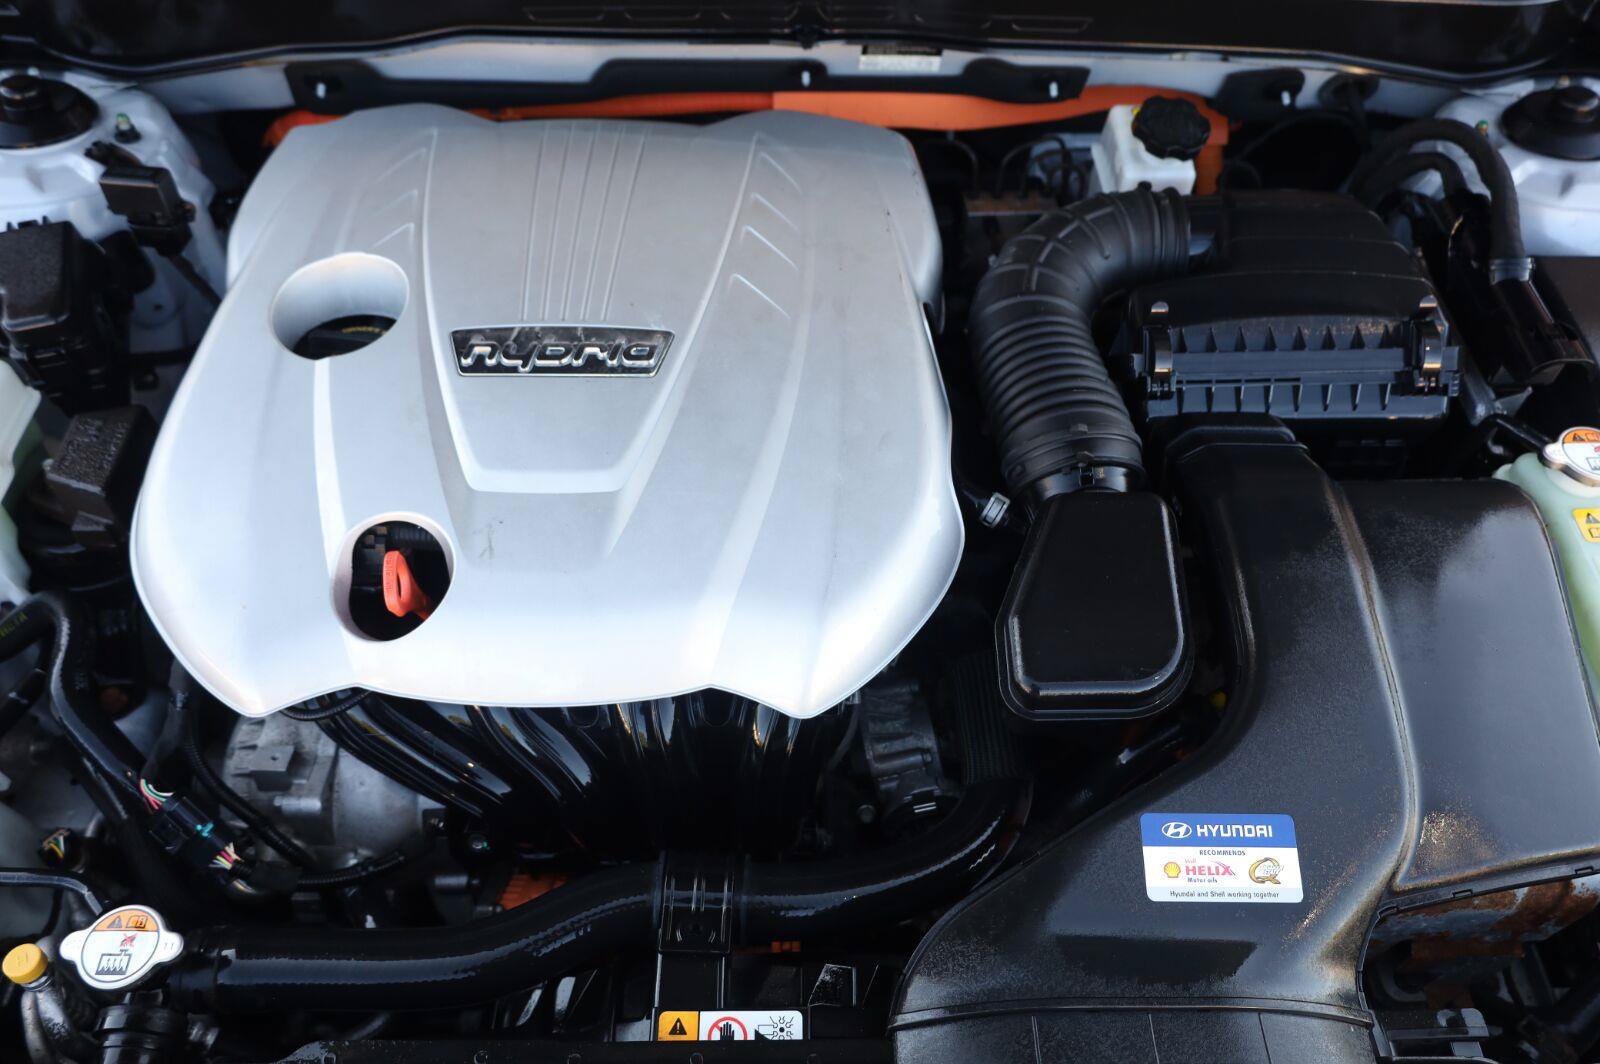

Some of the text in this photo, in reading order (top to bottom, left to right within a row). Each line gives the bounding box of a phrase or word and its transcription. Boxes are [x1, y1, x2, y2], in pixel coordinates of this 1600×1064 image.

[1196, 824, 1273, 838] HYUNDAI
[1185, 864, 1234, 876] HELIX
[1170, 890, 1196, 898] Hyundai
[1227, 891, 1252, 899] working
[1253, 891, 1279, 899] together
